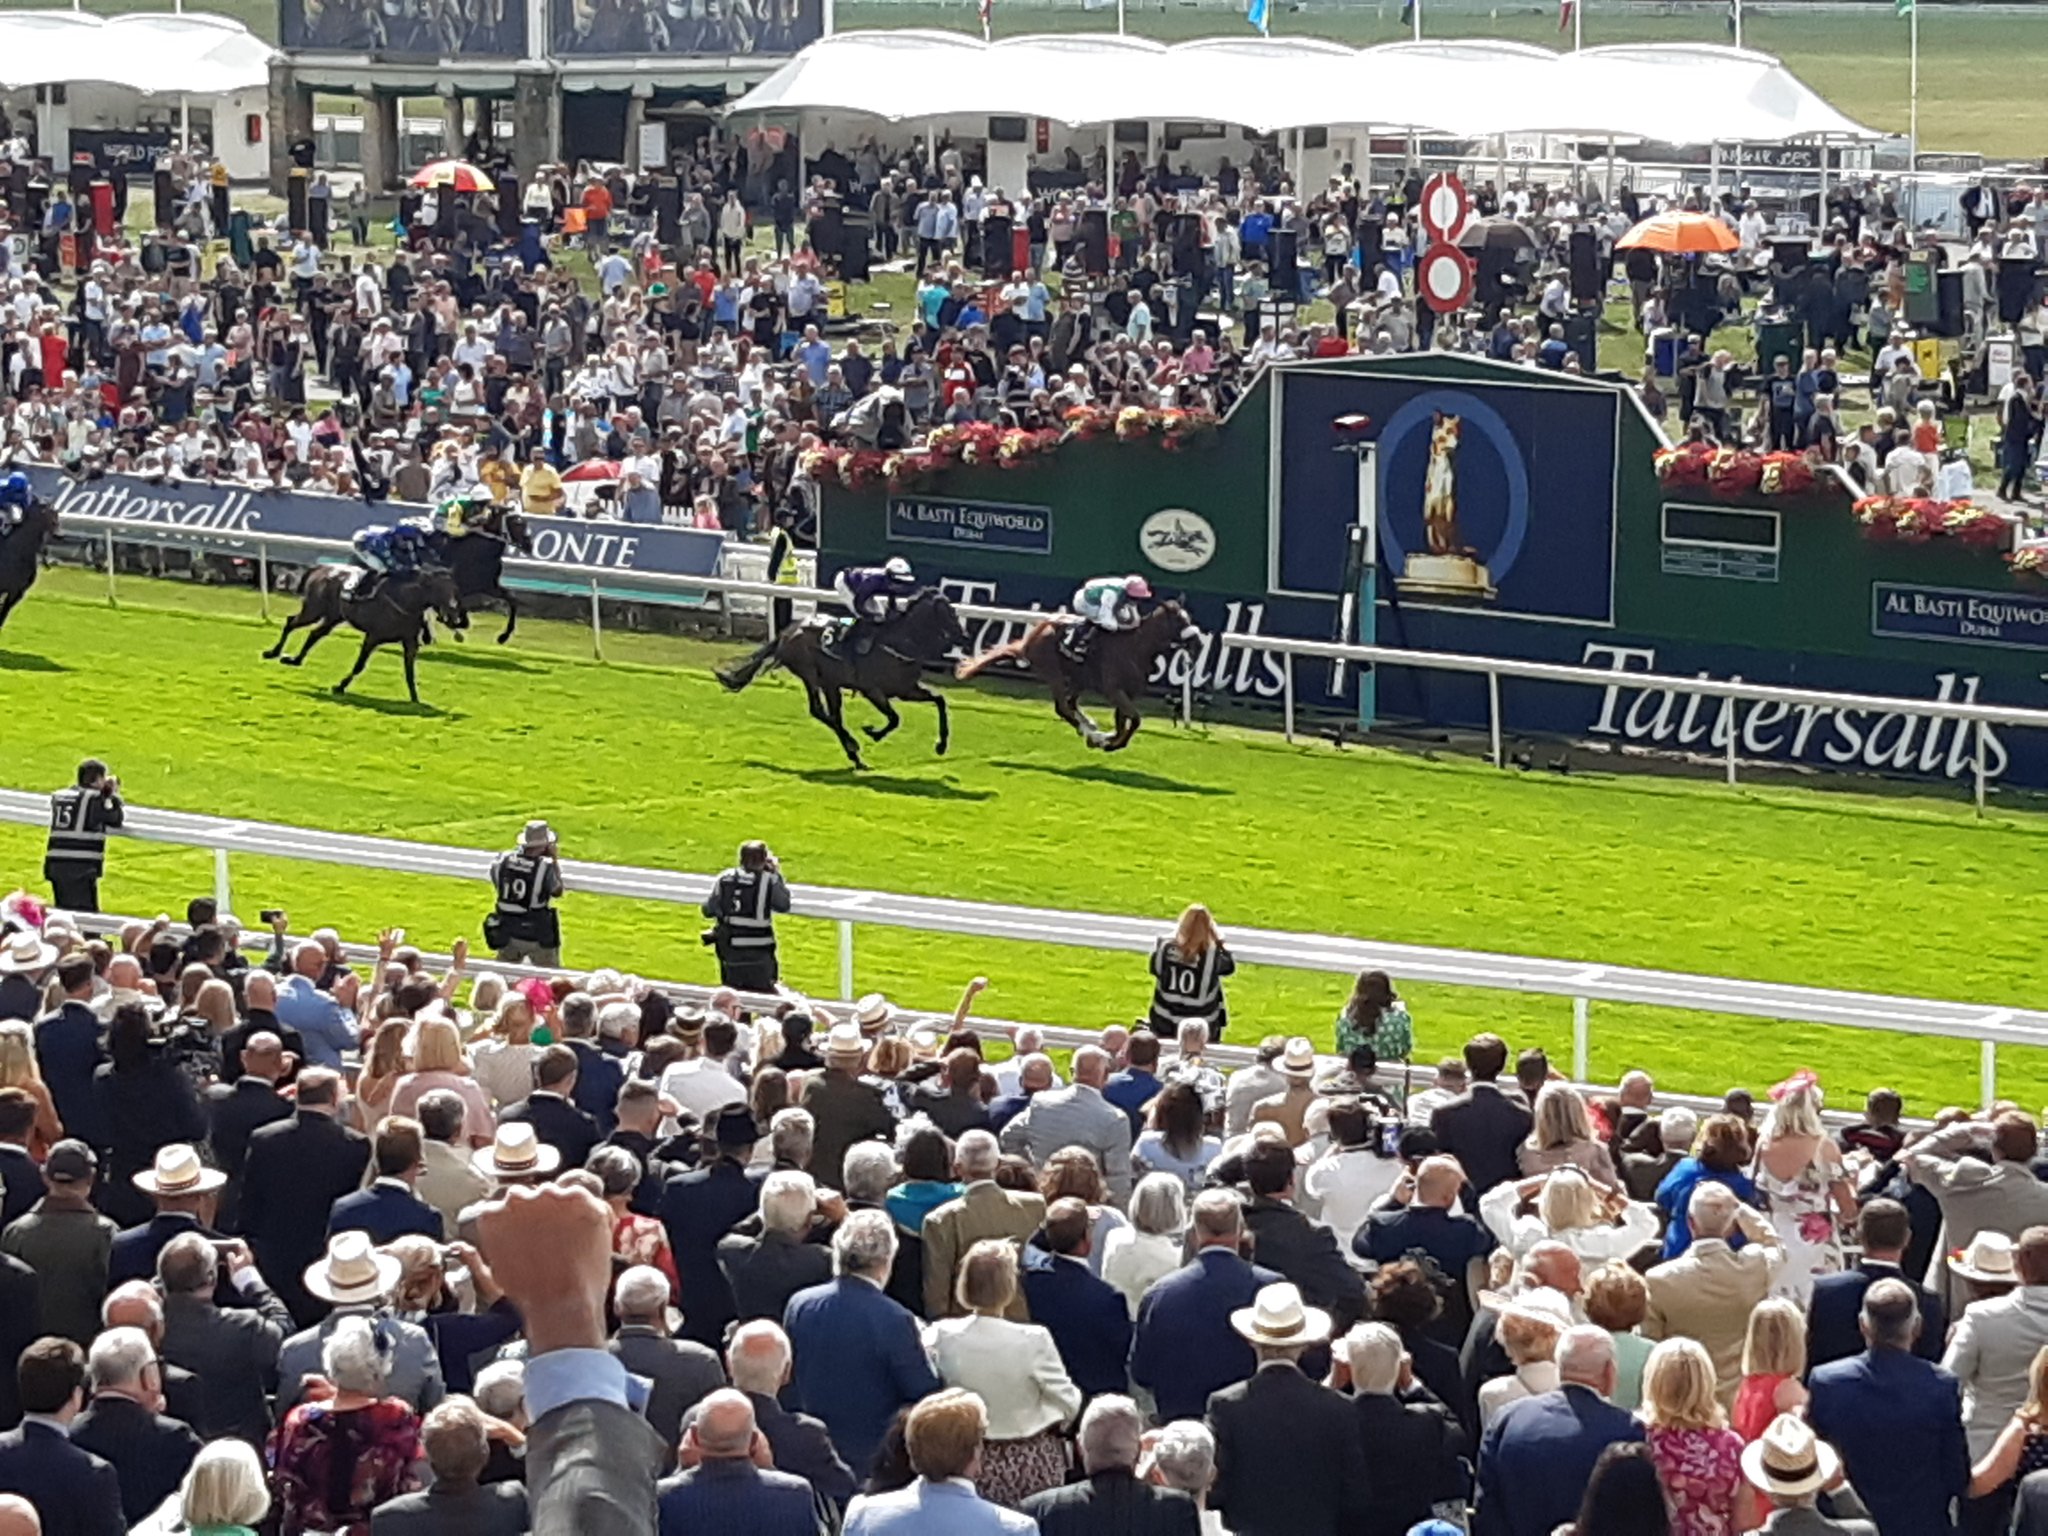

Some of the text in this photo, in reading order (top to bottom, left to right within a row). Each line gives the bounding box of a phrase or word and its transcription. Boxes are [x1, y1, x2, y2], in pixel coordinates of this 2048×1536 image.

[897, 502, 914, 521] AL
[917, 504, 954, 524] BASTI
[502, 528, 640, 568] ONTE
[1885, 592, 2048, 625] AL BASTI EQUIWO
[1582, 641, 2009, 779] Tattersalls
[54, 804, 72, 828] 15
[1167, 965, 1196, 994] 10
